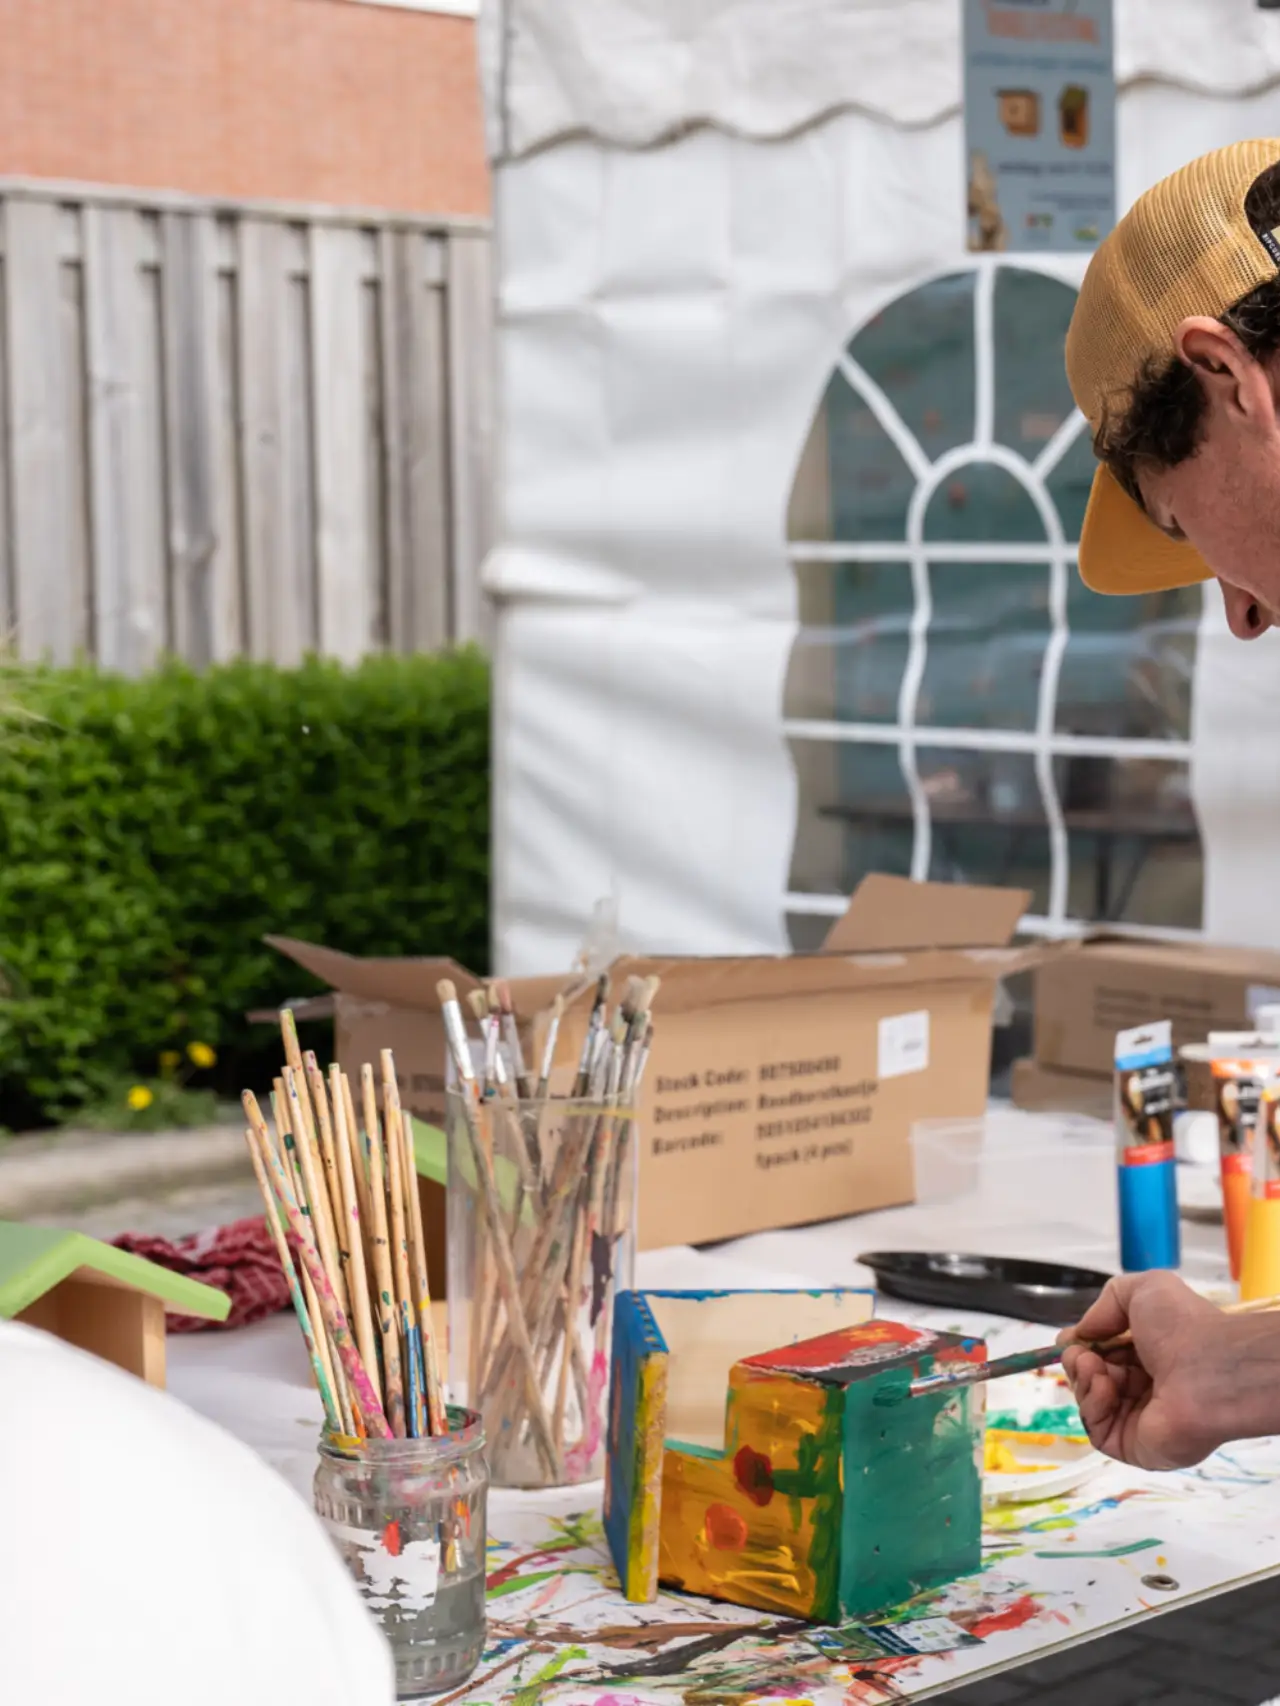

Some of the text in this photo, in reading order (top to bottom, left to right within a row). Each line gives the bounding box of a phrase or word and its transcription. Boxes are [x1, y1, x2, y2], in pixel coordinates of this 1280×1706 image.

[655, 1071, 699, 1095] Stock
[705, 1066, 749, 1088] Code:
[653, 1097, 749, 1125] Description:
[651, 1130, 722, 1156] Barcode:
